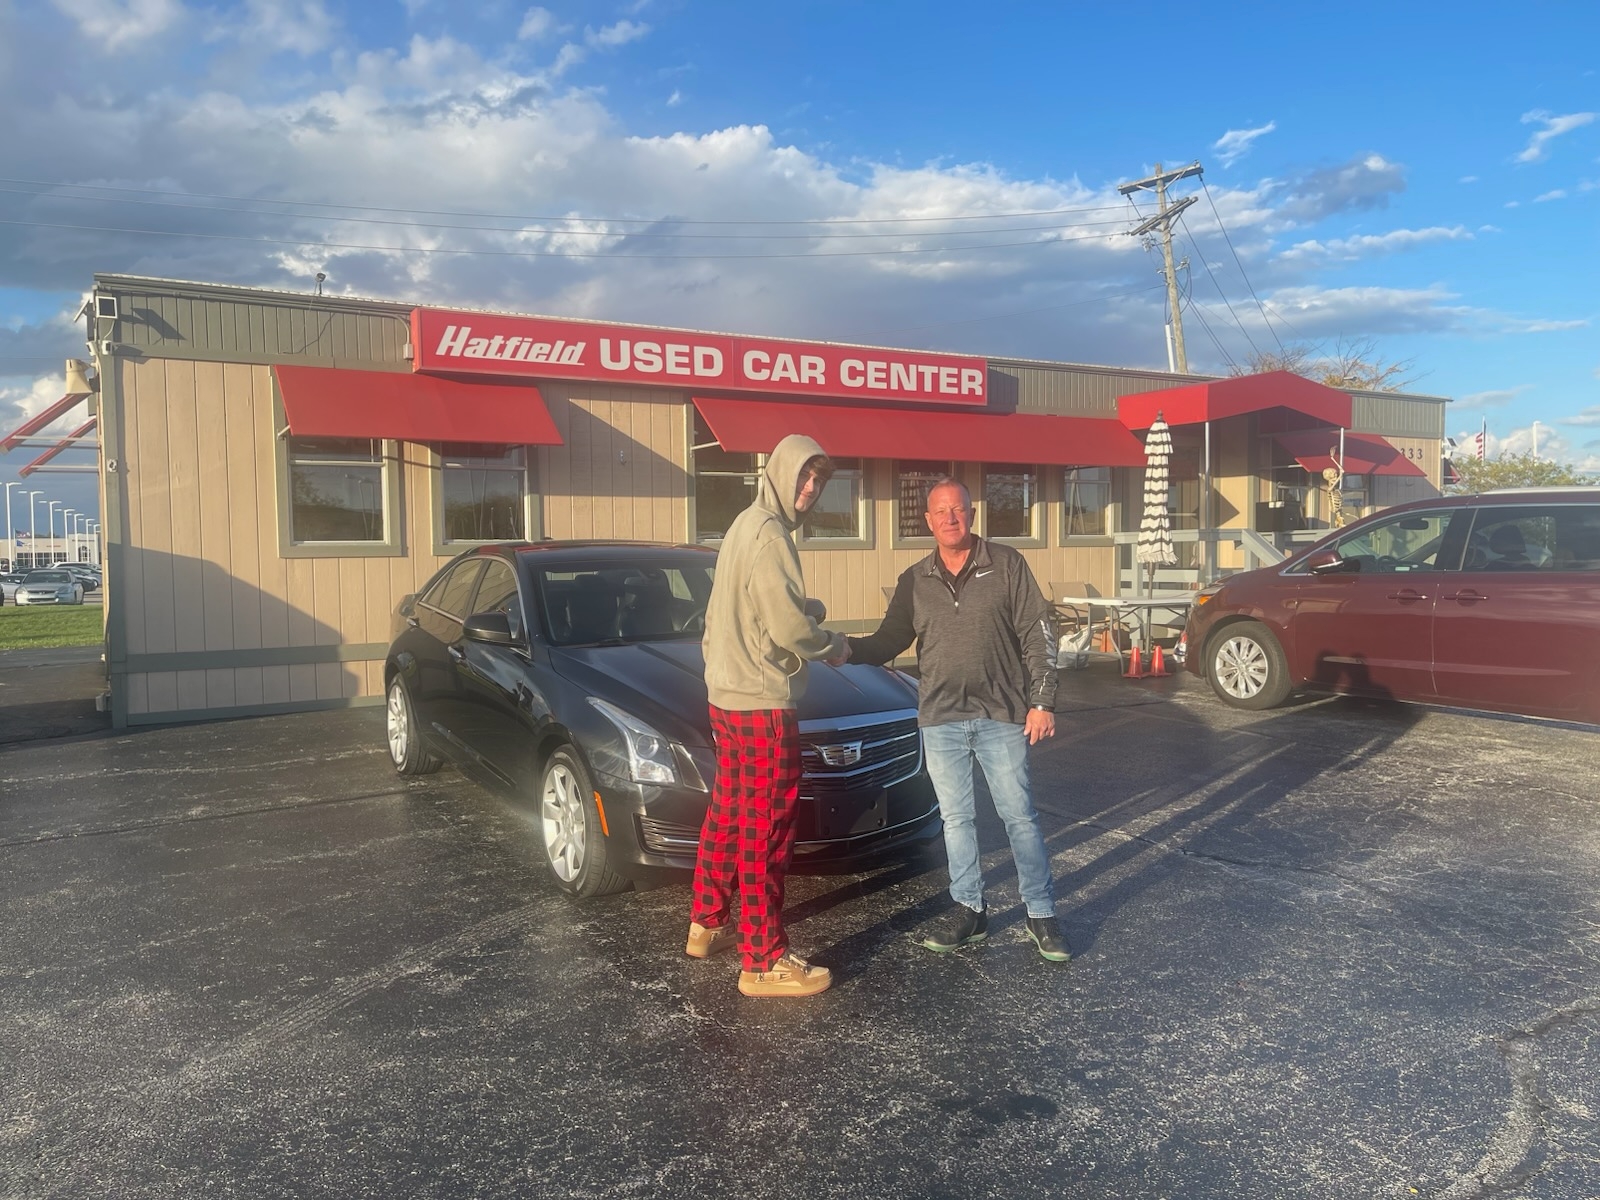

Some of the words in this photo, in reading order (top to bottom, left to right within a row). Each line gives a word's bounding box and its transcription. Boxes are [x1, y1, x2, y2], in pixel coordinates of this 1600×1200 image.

[435, 325, 586, 366] Hatfield
[599, 338, 723, 377] USED
[743, 350, 826, 385] CAR
[839, 359, 983, 396] CENTER
